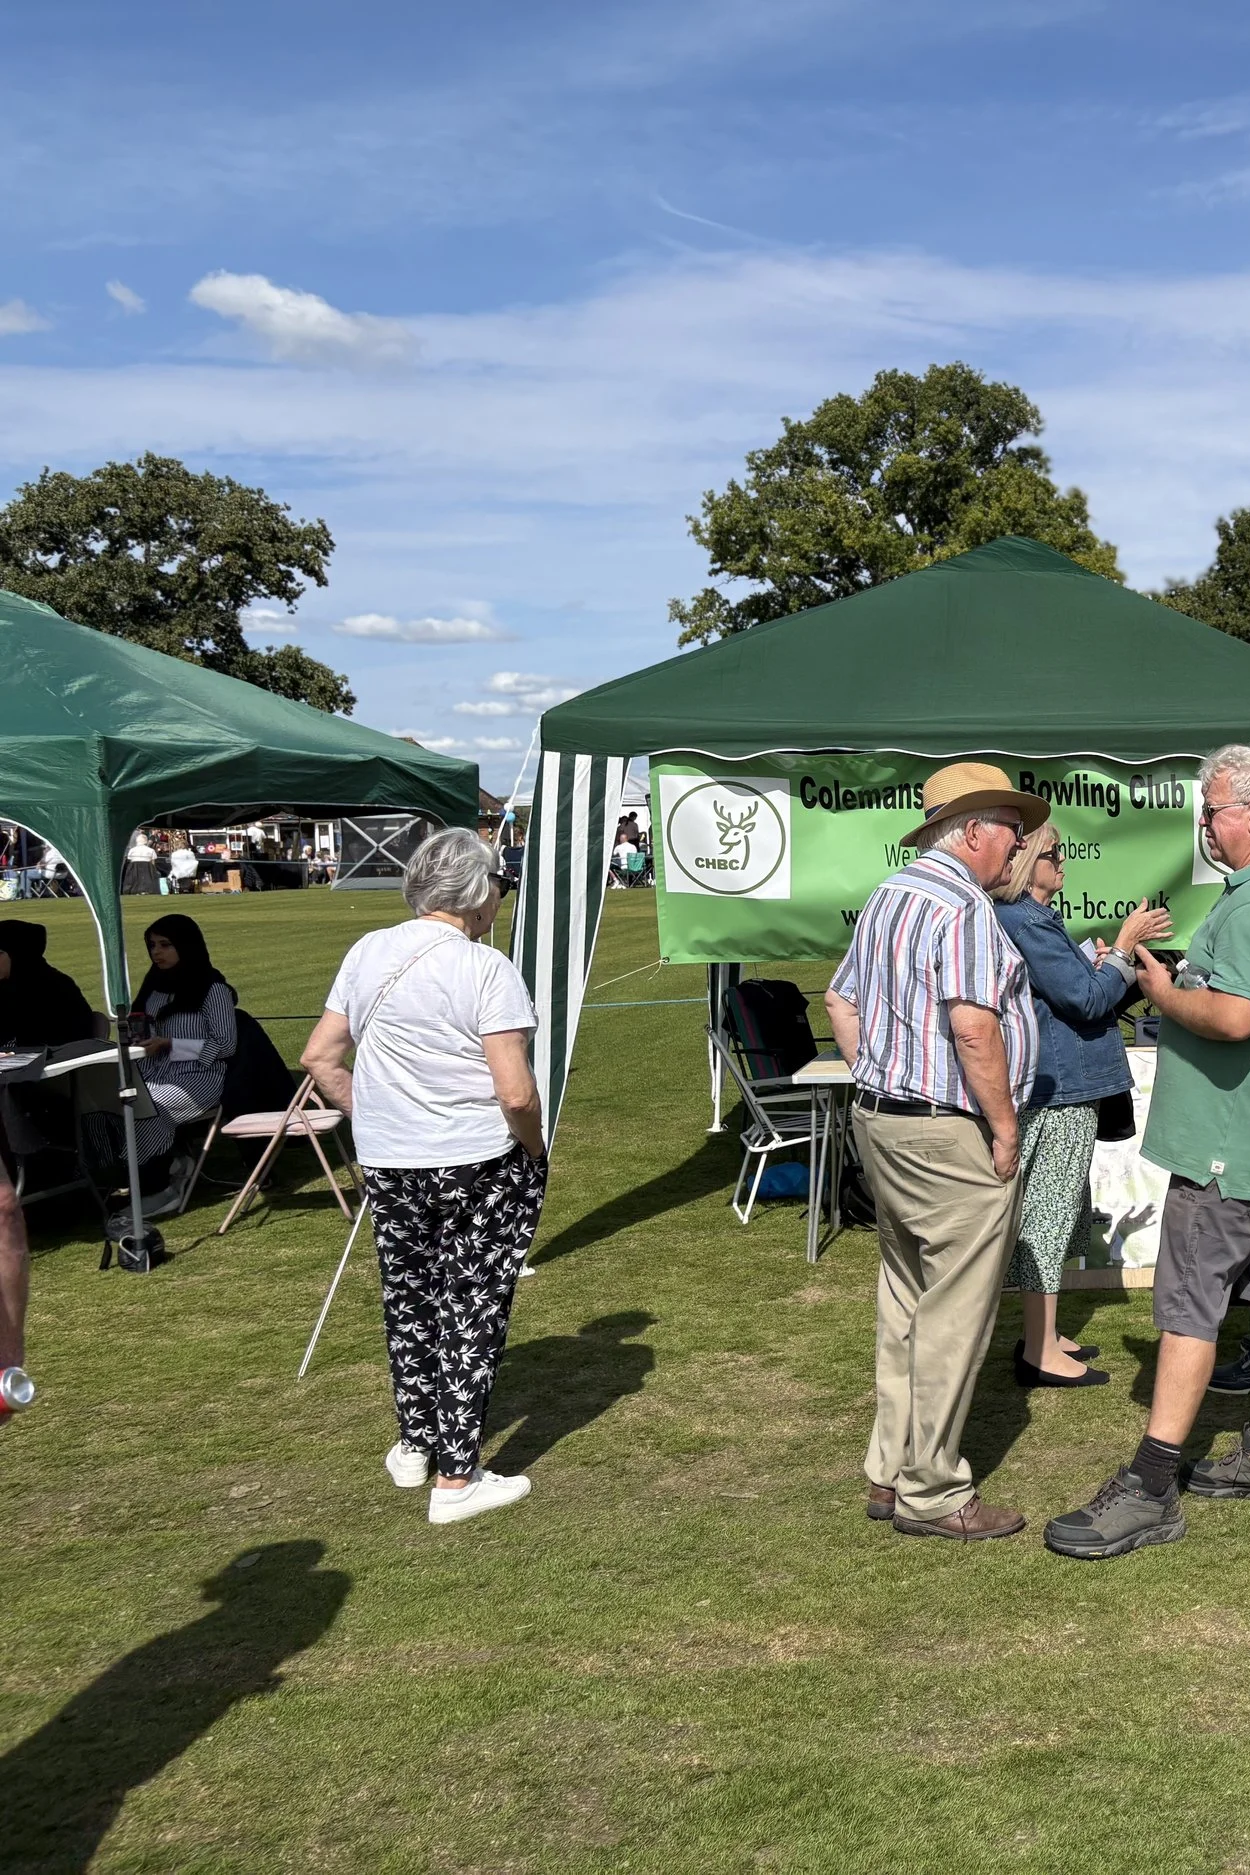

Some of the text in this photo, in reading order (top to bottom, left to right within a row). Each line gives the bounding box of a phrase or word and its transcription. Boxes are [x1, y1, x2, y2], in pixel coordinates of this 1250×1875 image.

[800, 770, 1186, 818] Colemans Bowling Club
[694, 856, 741, 871] CHBC
[885, 843, 909, 867] We
